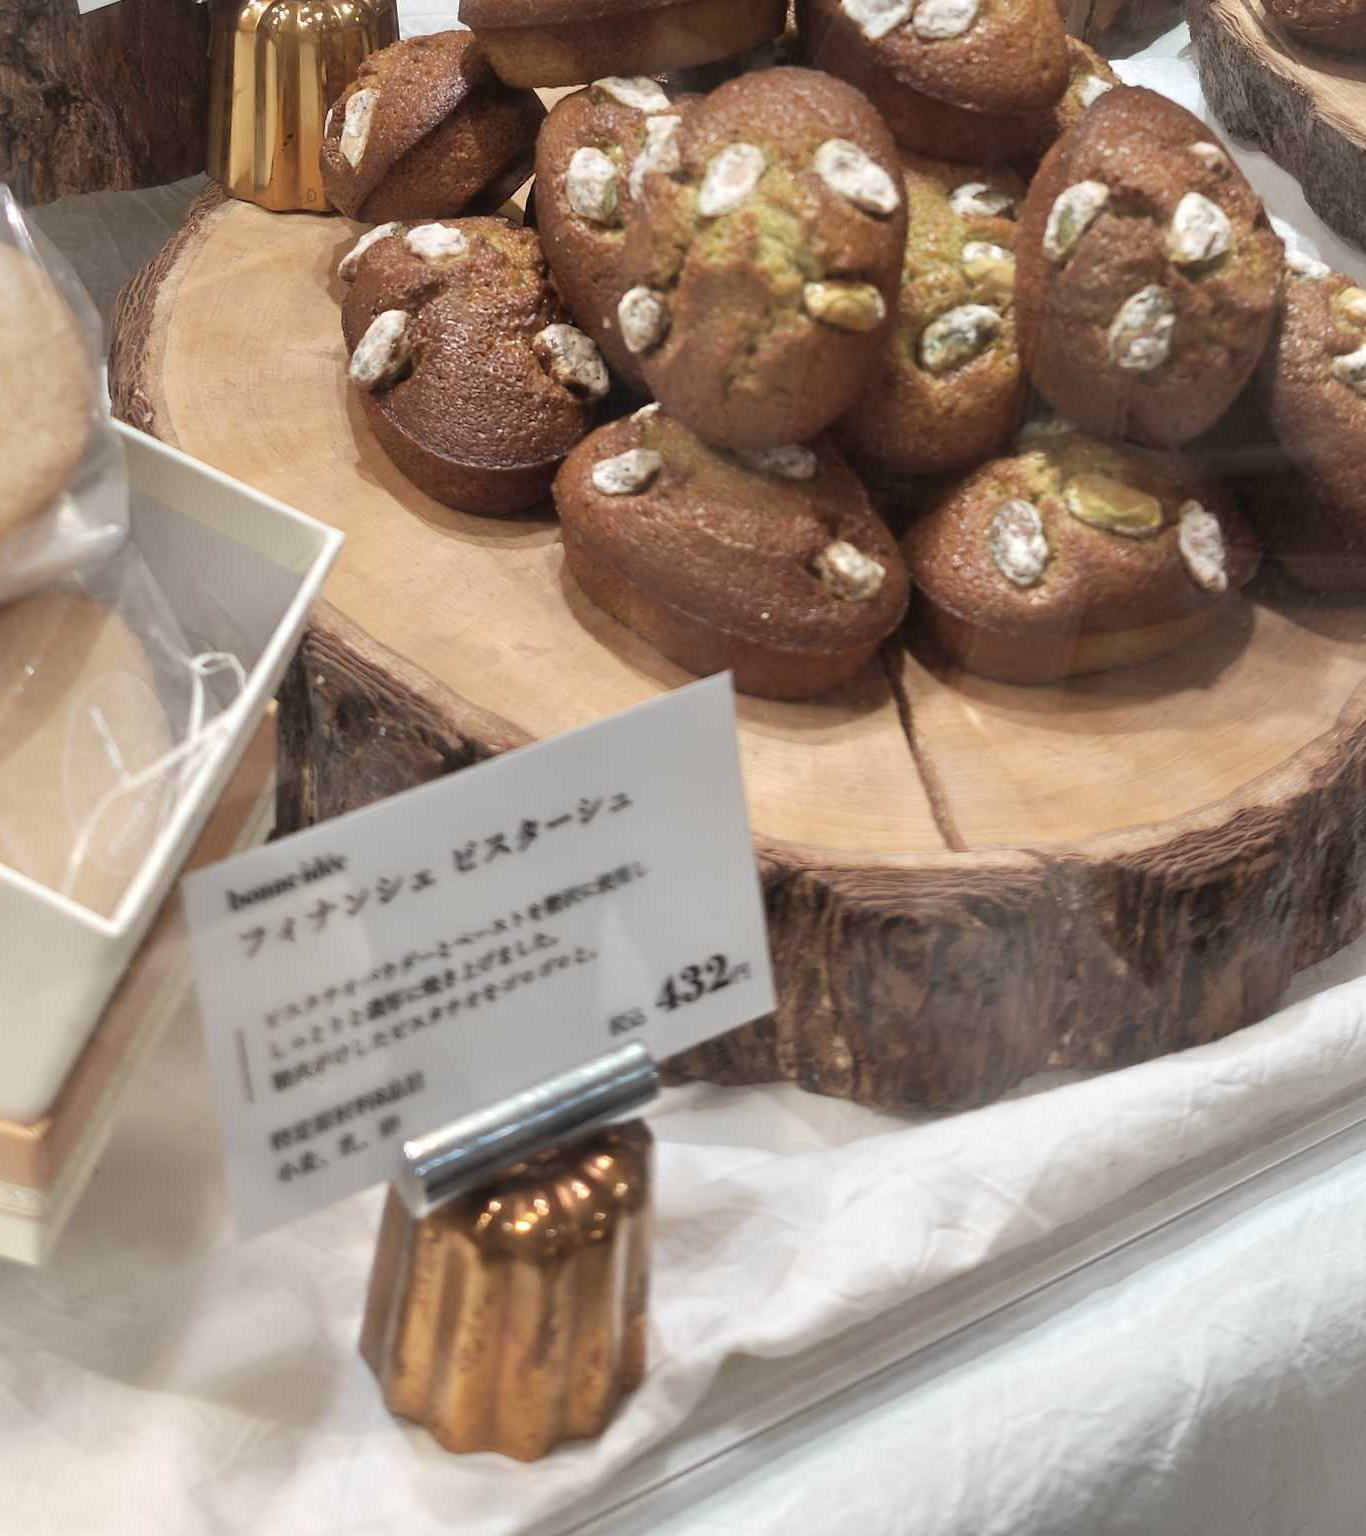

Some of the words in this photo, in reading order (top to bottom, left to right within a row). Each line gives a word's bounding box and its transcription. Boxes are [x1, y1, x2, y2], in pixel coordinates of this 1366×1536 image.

[238, 868, 437, 958] フィナンシェ
